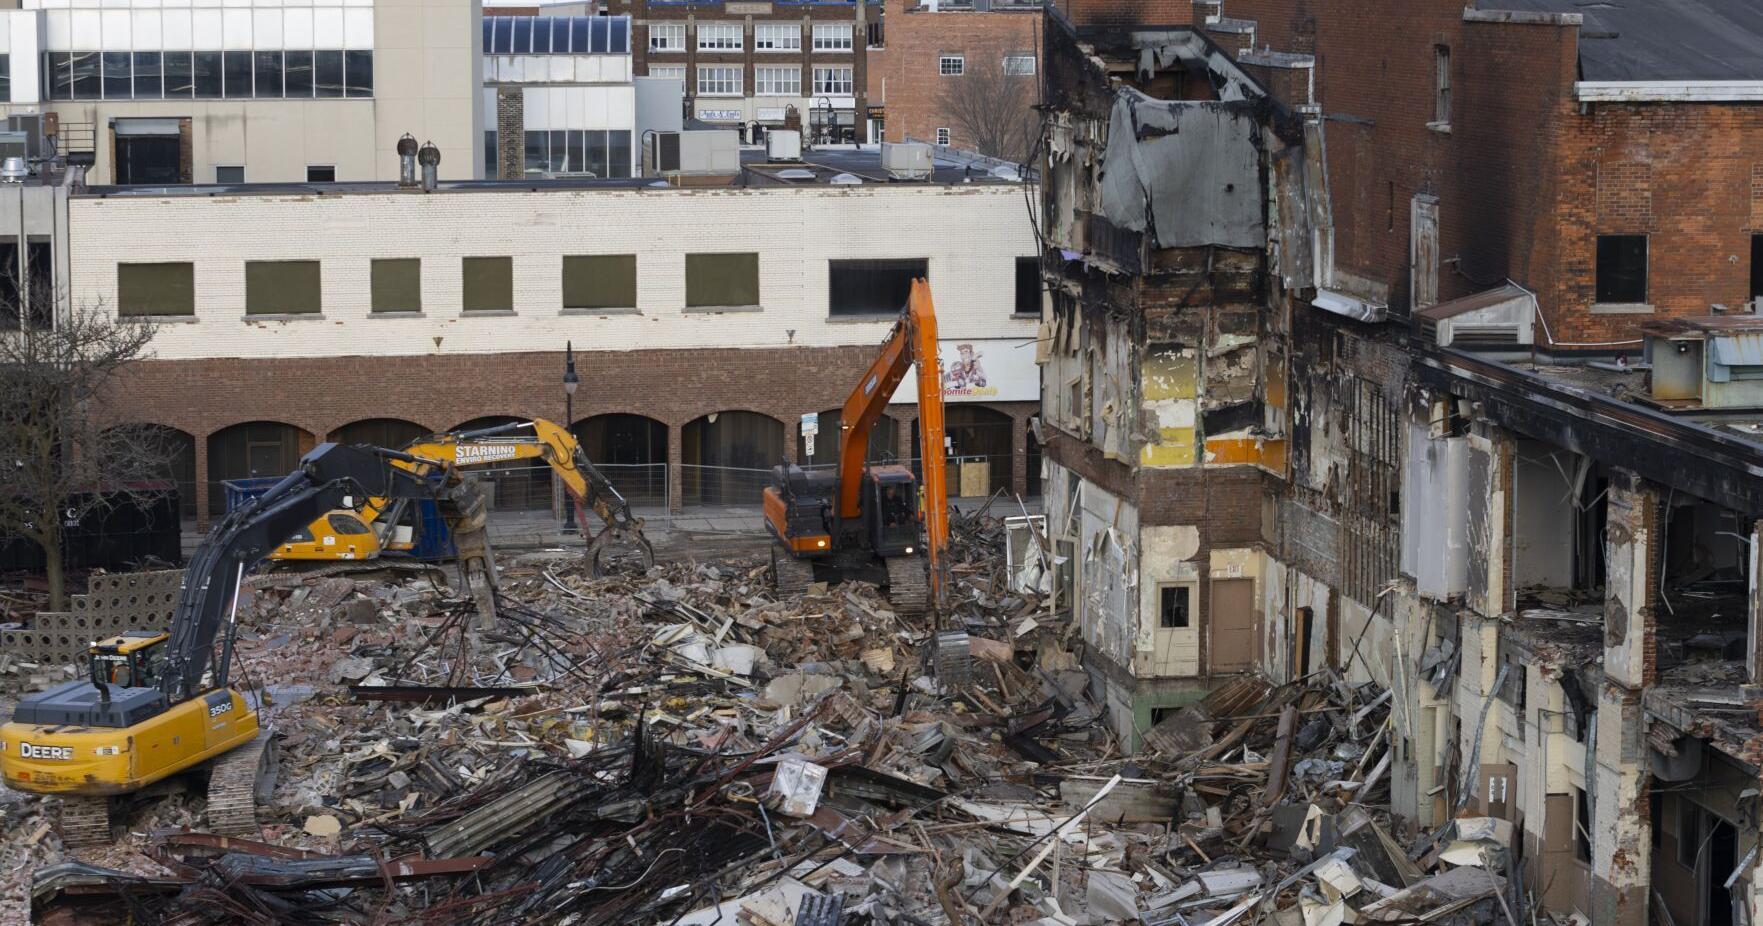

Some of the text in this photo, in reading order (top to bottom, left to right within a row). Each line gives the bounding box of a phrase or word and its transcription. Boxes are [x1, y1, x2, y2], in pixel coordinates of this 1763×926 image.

[455, 445, 516, 457] STARNINO
[455, 455, 482, 465] ENVIRO
[210, 702, 232, 717] 350G
[20, 742, 73, 760] DEERE
